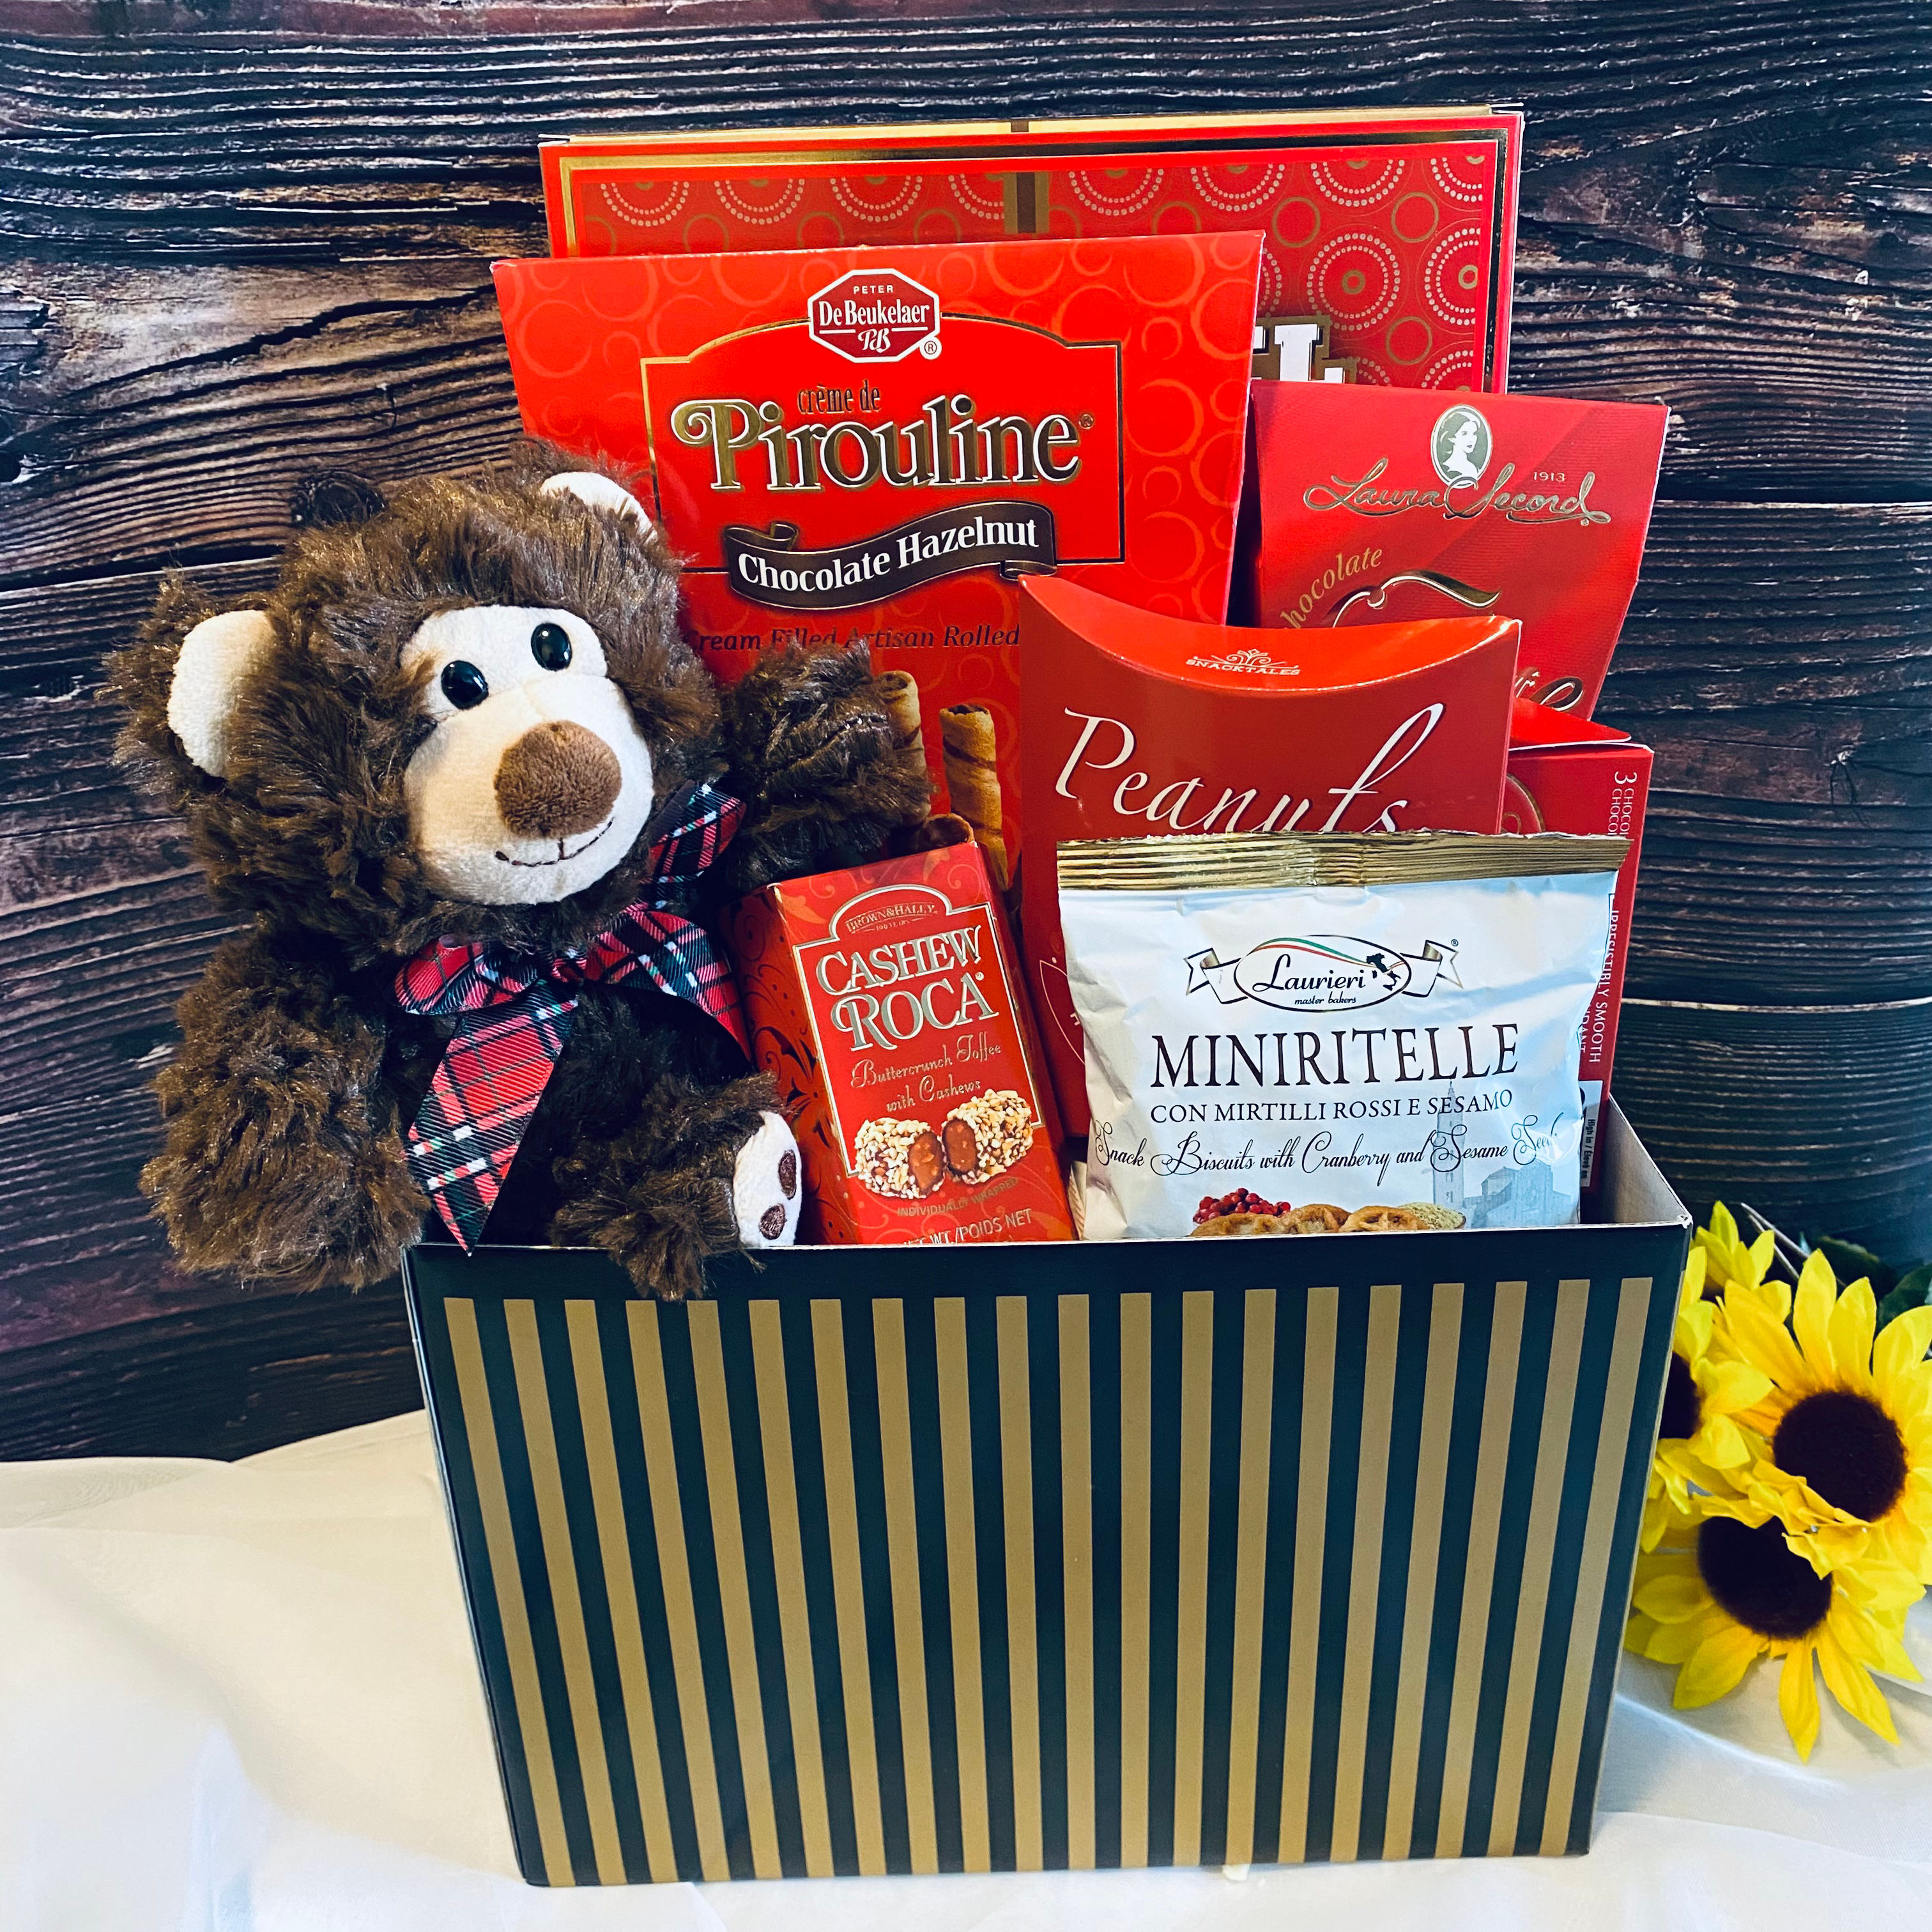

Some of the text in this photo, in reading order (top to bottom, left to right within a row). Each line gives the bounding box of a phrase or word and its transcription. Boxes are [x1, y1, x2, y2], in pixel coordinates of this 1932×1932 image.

[854, 285, 894, 295] PETER
[818, 298, 930, 326] De Beukelaer
[798, 379, 881, 414] crème de
[671, 394, 1082, 490] Pirouline
[1303, 457, 1611, 524] Laura Secord
[1533, 471, 1565, 482] 1913
[739, 516, 1039, 592] Chocolate Hazelnut
[1280, 548, 1383, 629] hocolate
[943, 624, 1020, 647] Rolled
[1186, 659, 1301, 675] SNACKTALES
[1055, 703, 1445, 832] Peanuts
[1614, 771, 1637, 785] 3
[816, 926, 982, 996] CASHEW
[1252, 954, 1366, 992] Laurieri
[831, 971, 999, 1051] ROCA
[1294, 991, 1356, 1005] master bakers
[1589, 1002, 1608, 1062] SMOOTH
[851, 1031, 1002, 1088] Buttercrunch Toffee
[1150, 1023, 1519, 1087] MINIRITELLE
[886, 1073, 981, 1112] with Cashews
[1151, 1089, 1513, 1123] CON MIRTILLI ROSSI E SESAMO
[1094, 1121, 1147, 1167] Snack
[1150, 1131, 1255, 1176] Biscuits
[1260, 1136, 1301, 1170] with
[1301, 1131, 1391, 1187] Cranberry
[1396, 1130, 1437, 1163] and
[1430, 1124, 1509, 1173] Sesame
[897, 1177, 1018, 1217] INDIVIDUALLY WRAPPED
[1005, 1208, 1032, 1229] NET
